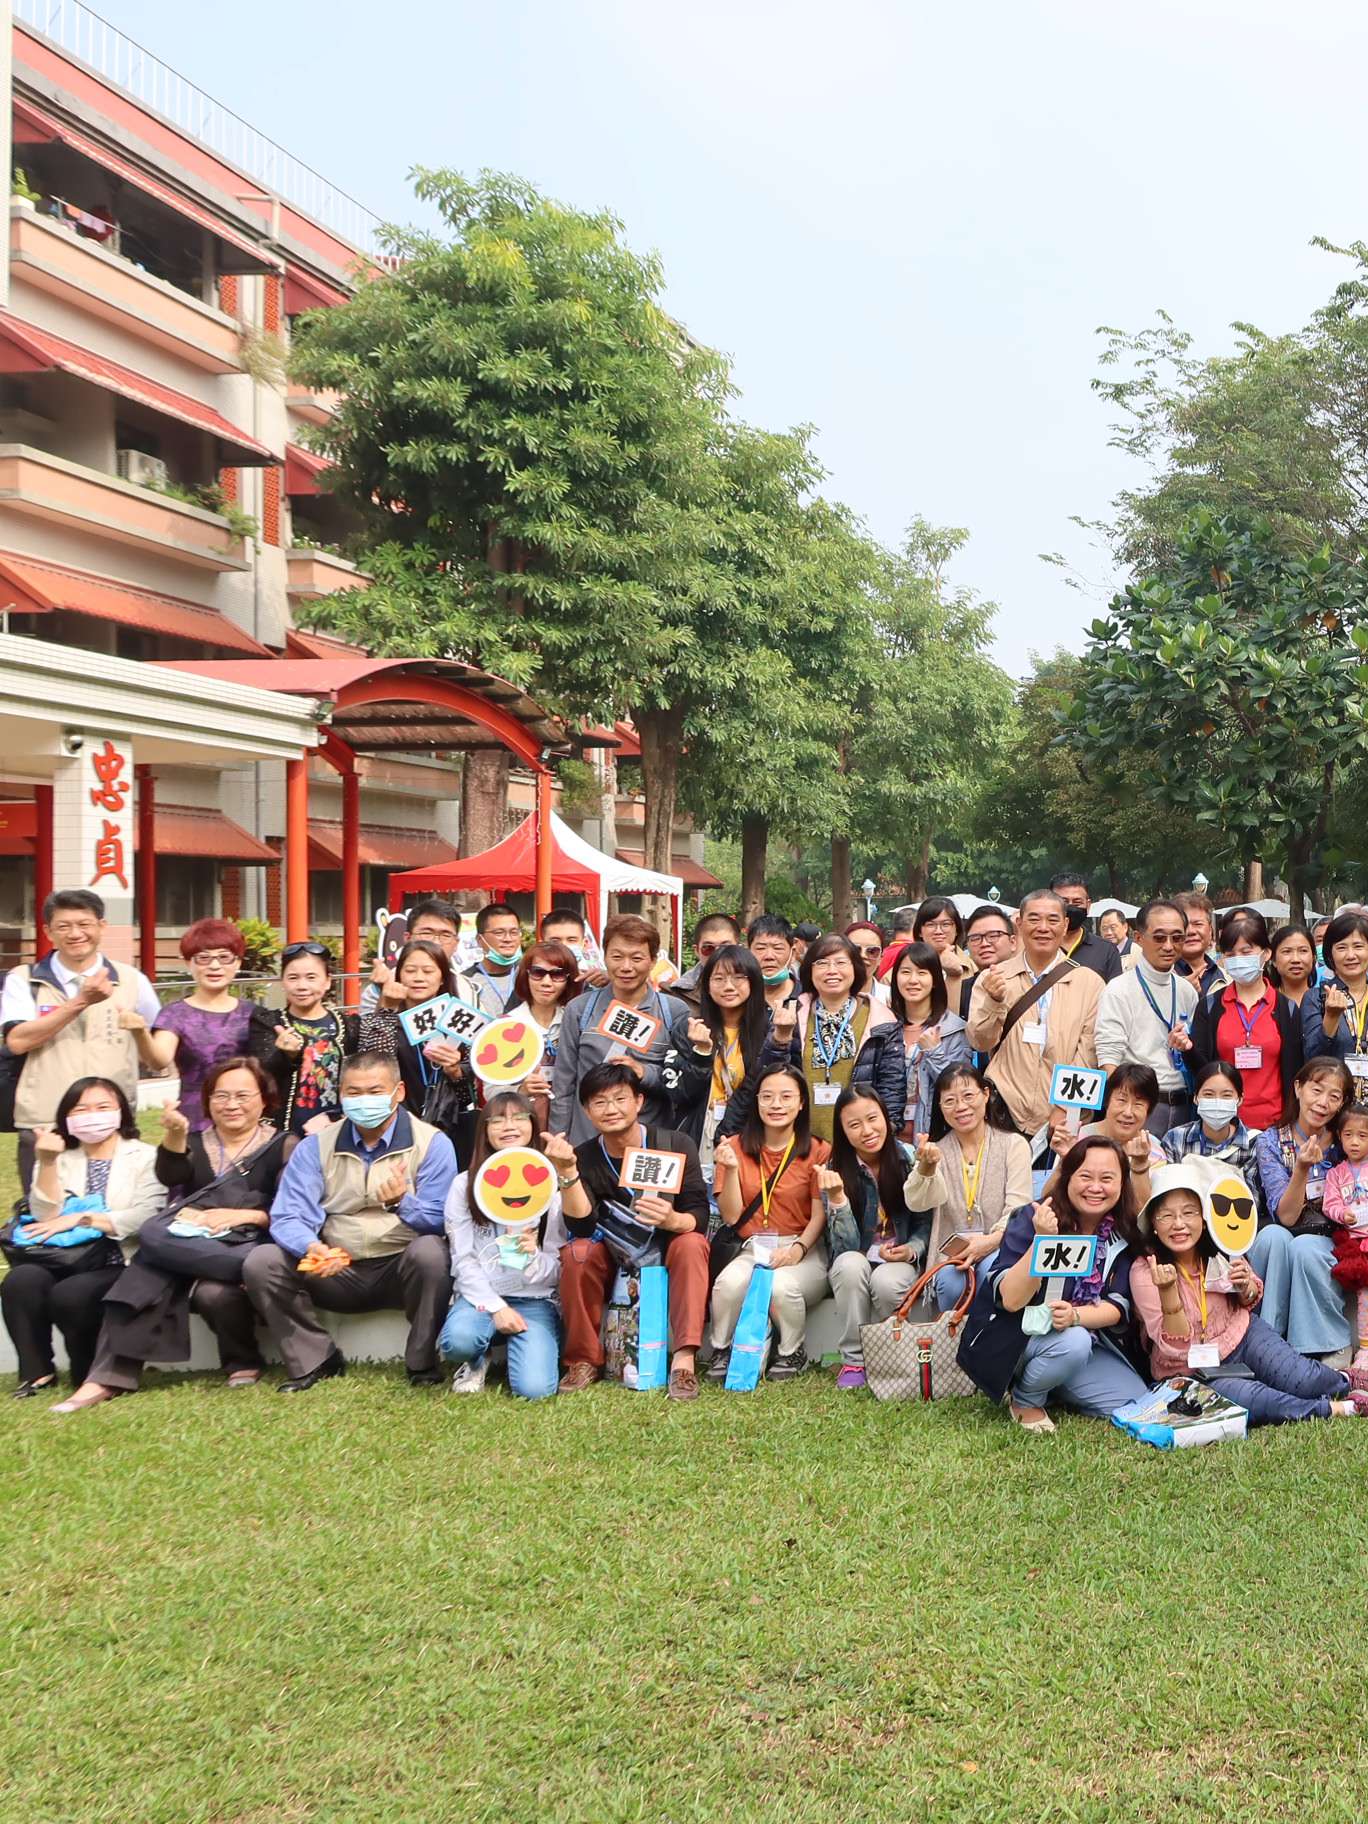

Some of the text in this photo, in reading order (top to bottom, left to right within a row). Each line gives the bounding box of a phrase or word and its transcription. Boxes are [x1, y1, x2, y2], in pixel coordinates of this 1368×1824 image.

[89, 740, 130, 890] 忠貞
[447, 1008, 485, 1038] 好!
[1061, 1073, 1098, 1101] 水!
[1043, 1242, 1088, 1271] 水!
